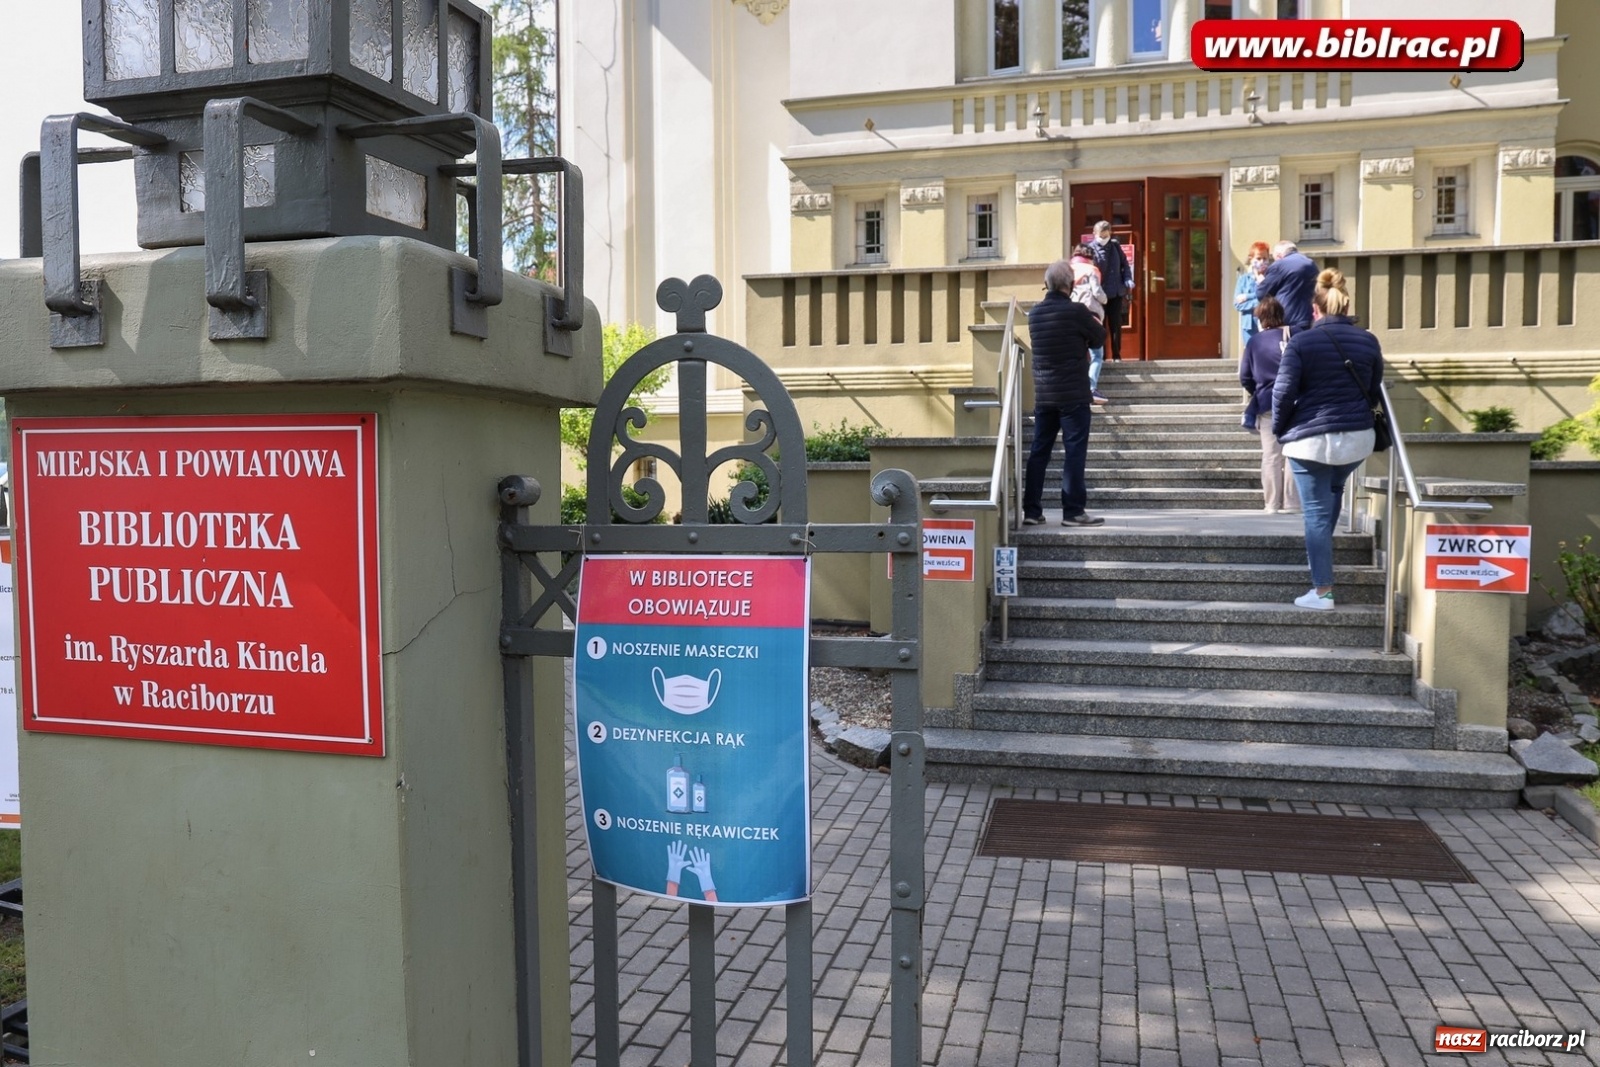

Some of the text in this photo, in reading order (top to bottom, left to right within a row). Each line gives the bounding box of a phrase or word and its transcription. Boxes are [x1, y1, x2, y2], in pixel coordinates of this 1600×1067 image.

[36, 449, 346, 477] MIEJSKA I POWIATOWA
[78, 510, 301, 550] BIBLIOTEKA
[922, 532, 966, 544] ÓWIENIA
[1438, 538, 1517, 554] ZWROTY
[936, 559, 961, 567] WEJŚCIE
[1470, 568, 1499, 577] WEJŚCIE
[88, 566, 294, 608] PUBLICZNA
[629, 570, 754, 588] W BIBLIOTECE
[628, 598, 752, 620] OBOWIĄZUJE
[64, 633, 328, 674] im. Ryszarda Kincla
[612, 642, 681, 657] NOSZENIE
[684, 645, 759, 660] MASECZKI
[113, 680, 276, 715] w Raciborzu
[593, 725, 746, 750] 2 DEZYNFEKCJA RĄK
[598, 813, 779, 841] 3 NOSZENIE RĘKAWICZEK
